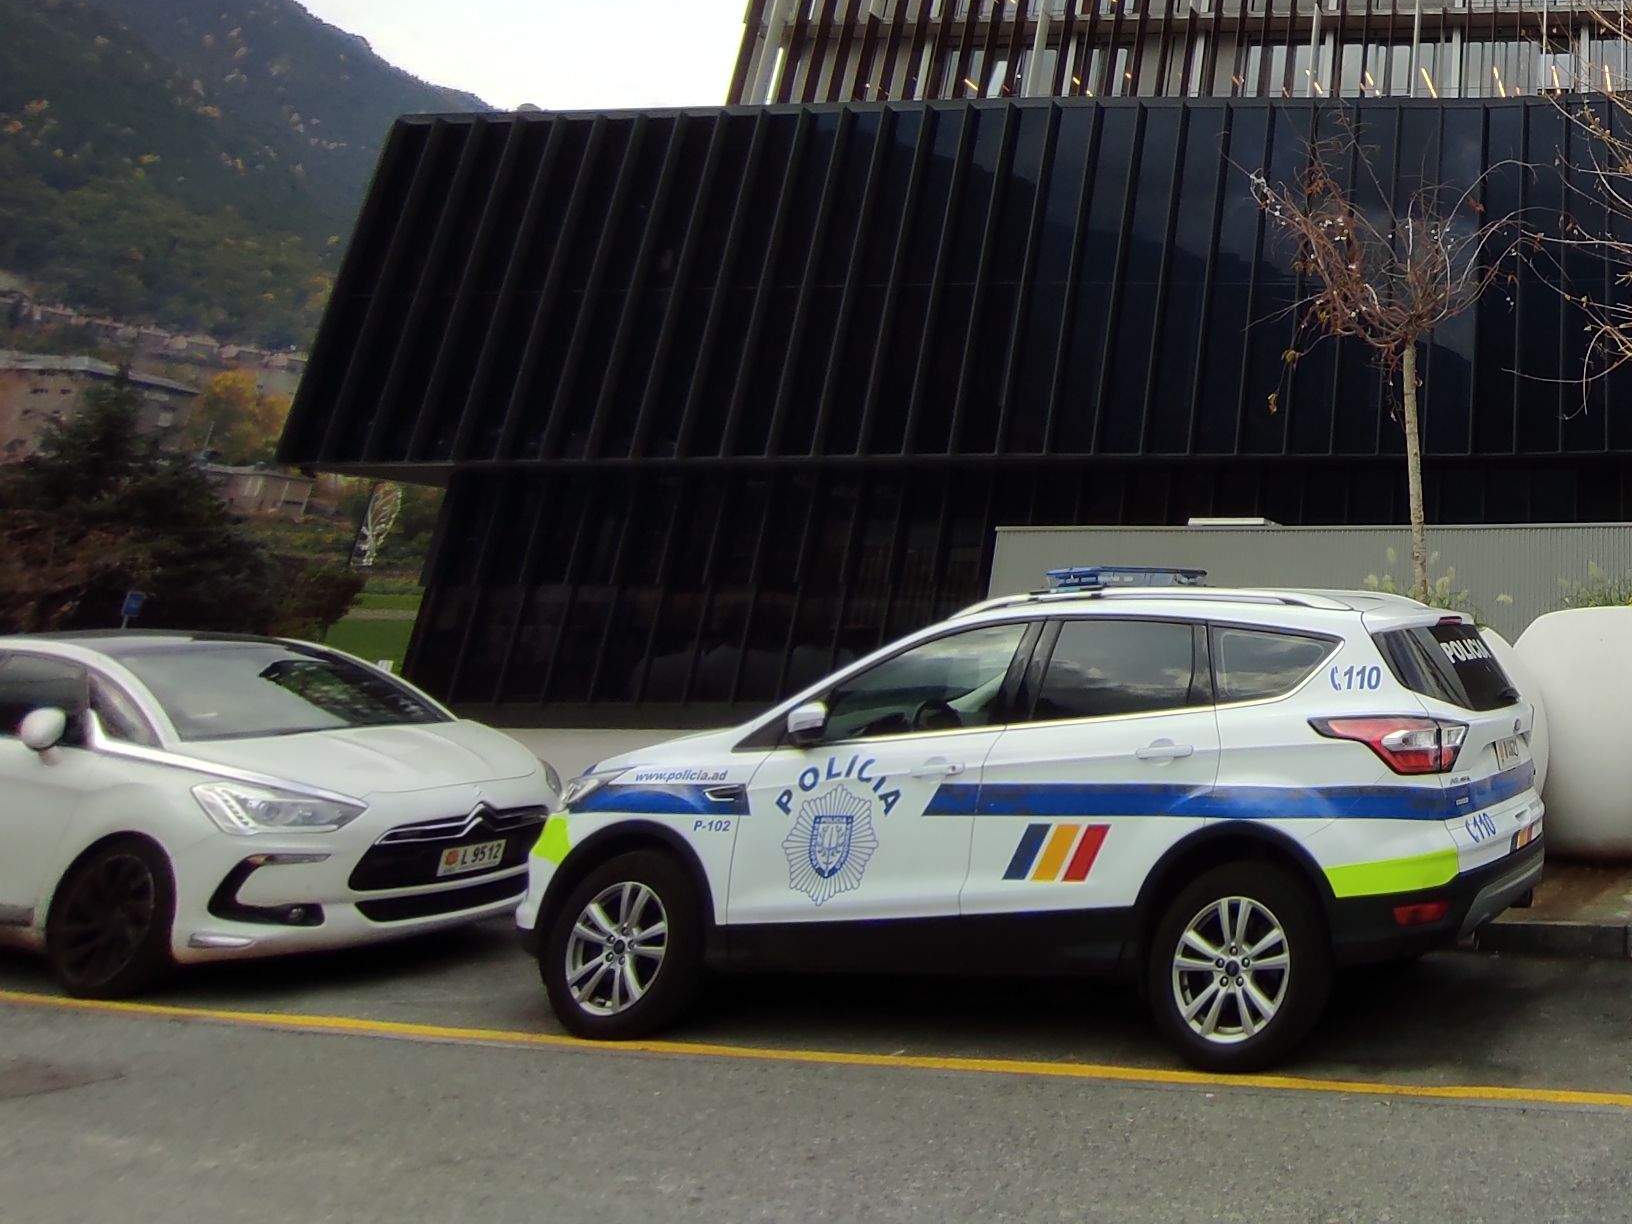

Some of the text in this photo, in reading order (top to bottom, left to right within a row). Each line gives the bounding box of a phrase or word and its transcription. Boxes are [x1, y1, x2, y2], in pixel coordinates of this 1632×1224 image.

[1343, 665, 1381, 690] 110
[635, 769, 728, 782] www.policia.ad
[776, 754, 901, 816] POLICIA
[693, 820, 731, 832] P-102
[1473, 812, 1496, 840] 110
